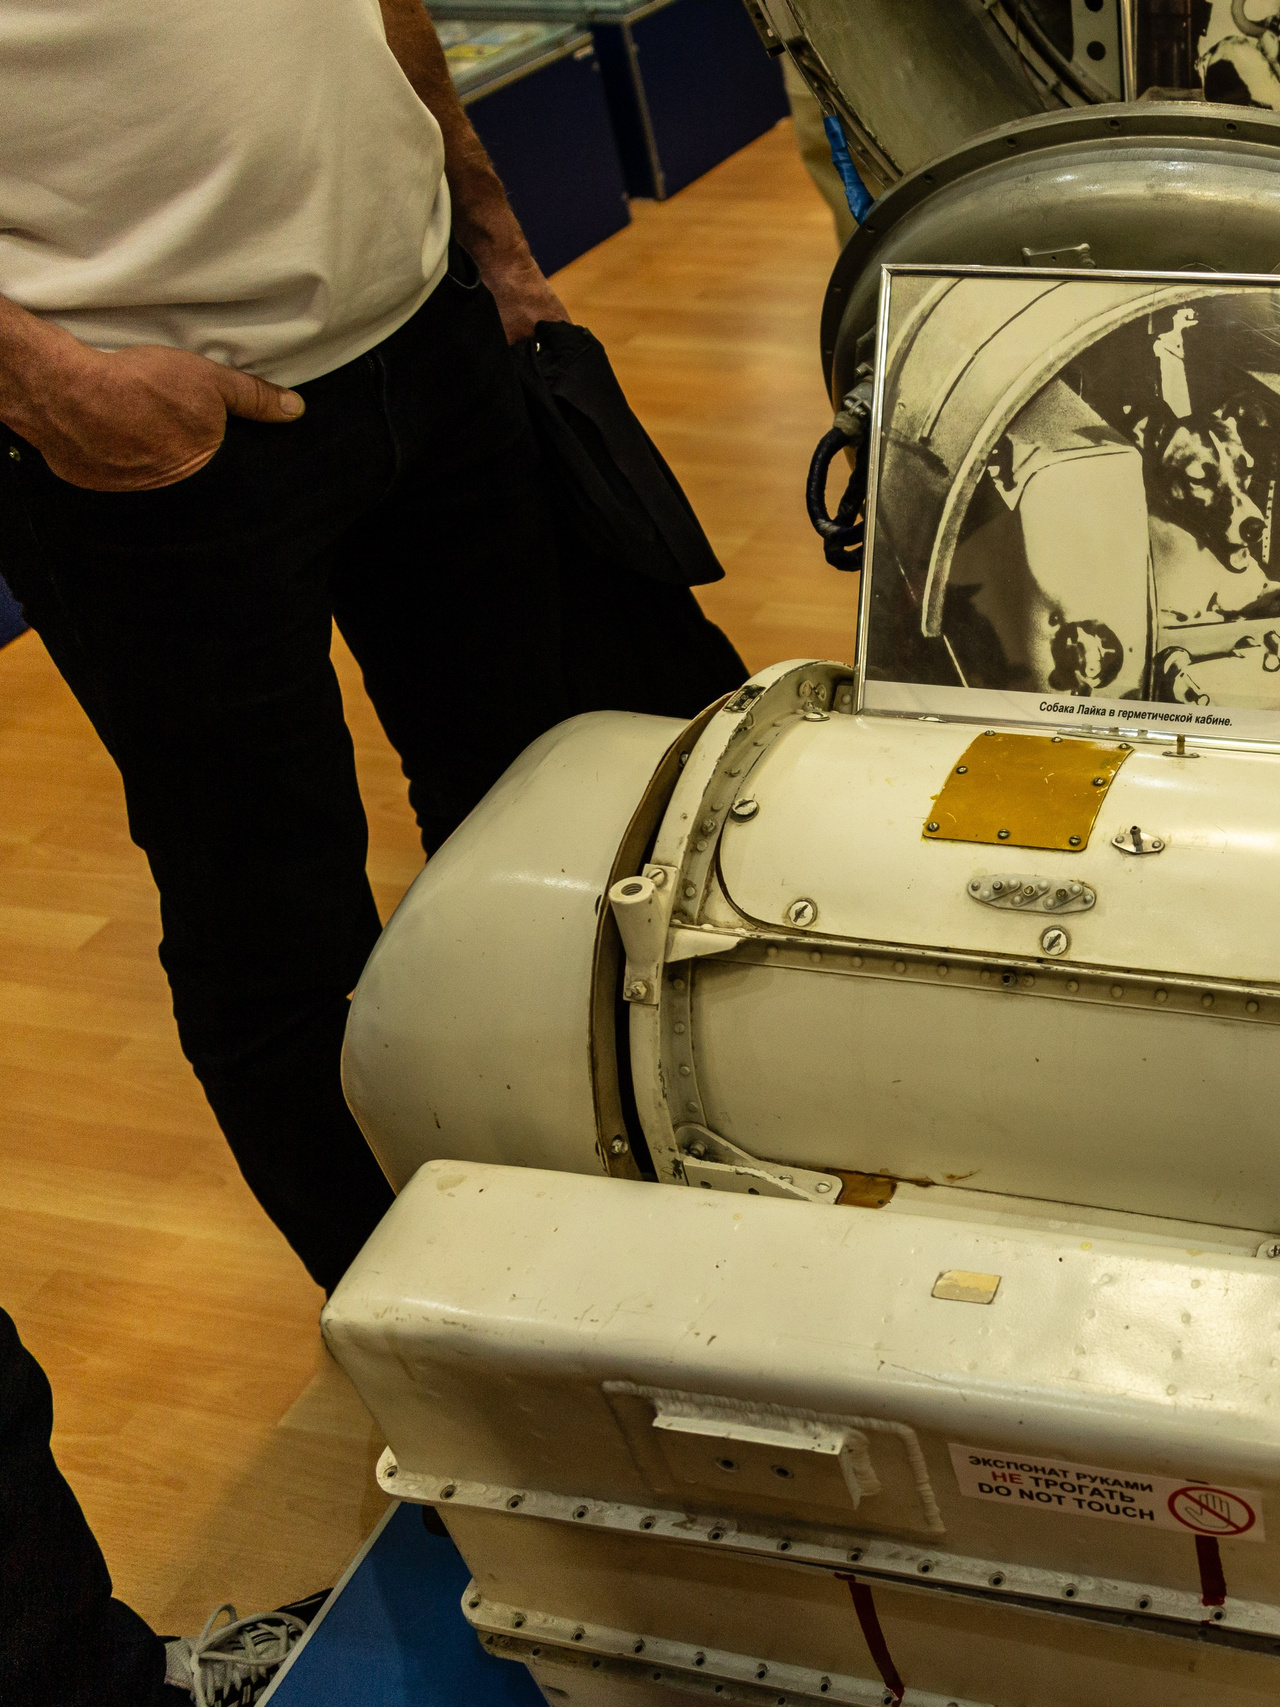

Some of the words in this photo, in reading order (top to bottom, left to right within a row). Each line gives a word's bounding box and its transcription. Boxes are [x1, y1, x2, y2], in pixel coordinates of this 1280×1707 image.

[1039, 701, 1074, 714] Собака
[1076, 704, 1106, 716] Лайка
[1117, 709, 1192, 723] герметической
[1195, 714, 1232, 726] кабине.
[969, 1455, 1069, 1478] ЭКСПОНАТ
[1076, 1472, 1153, 1492] РУКАМИ
[991, 1471, 1023, 1484] НЕ
[1029, 1476, 1135, 1502] ТРОГАТЬ
[978, 1483, 1011, 1496] DO
[1018, 1489, 1066, 1505] NOT
[1073, 1498, 1154, 1520] TOUCH
